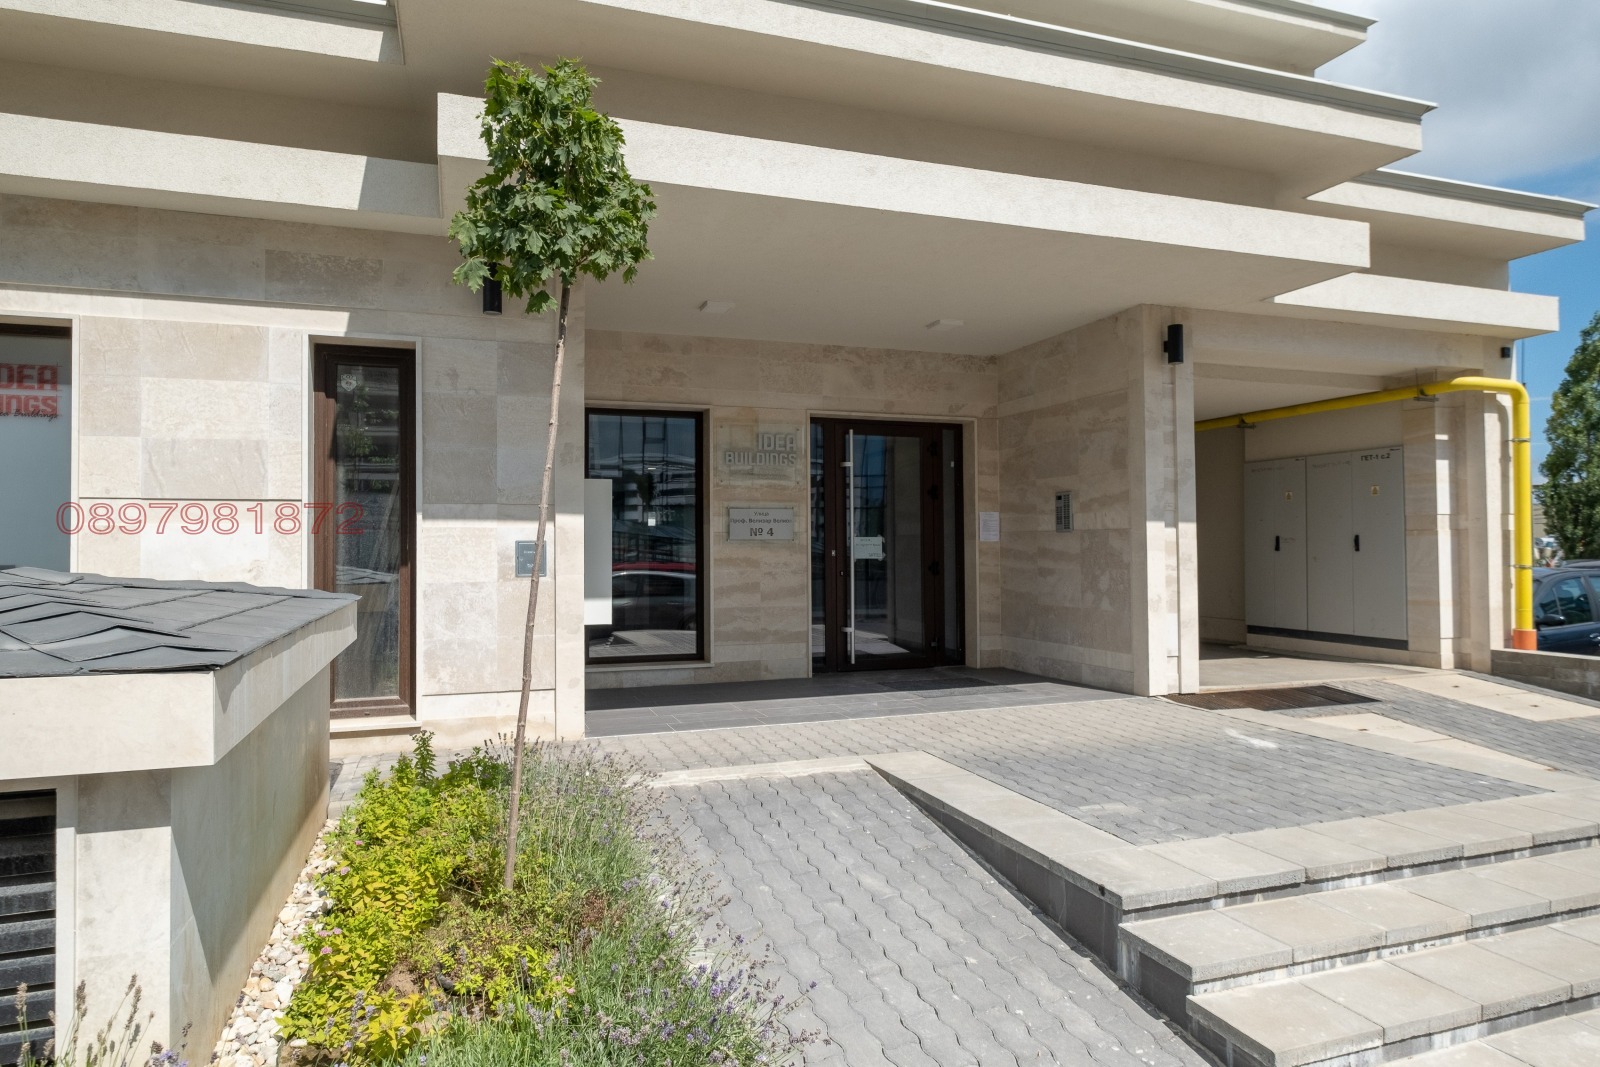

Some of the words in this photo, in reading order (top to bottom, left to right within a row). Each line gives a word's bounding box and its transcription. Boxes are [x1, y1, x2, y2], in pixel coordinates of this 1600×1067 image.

[758, 433, 795, 450] IDEA
[725, 451, 797, 466] BUILDINGS
[766, 527, 774, 537] 4
